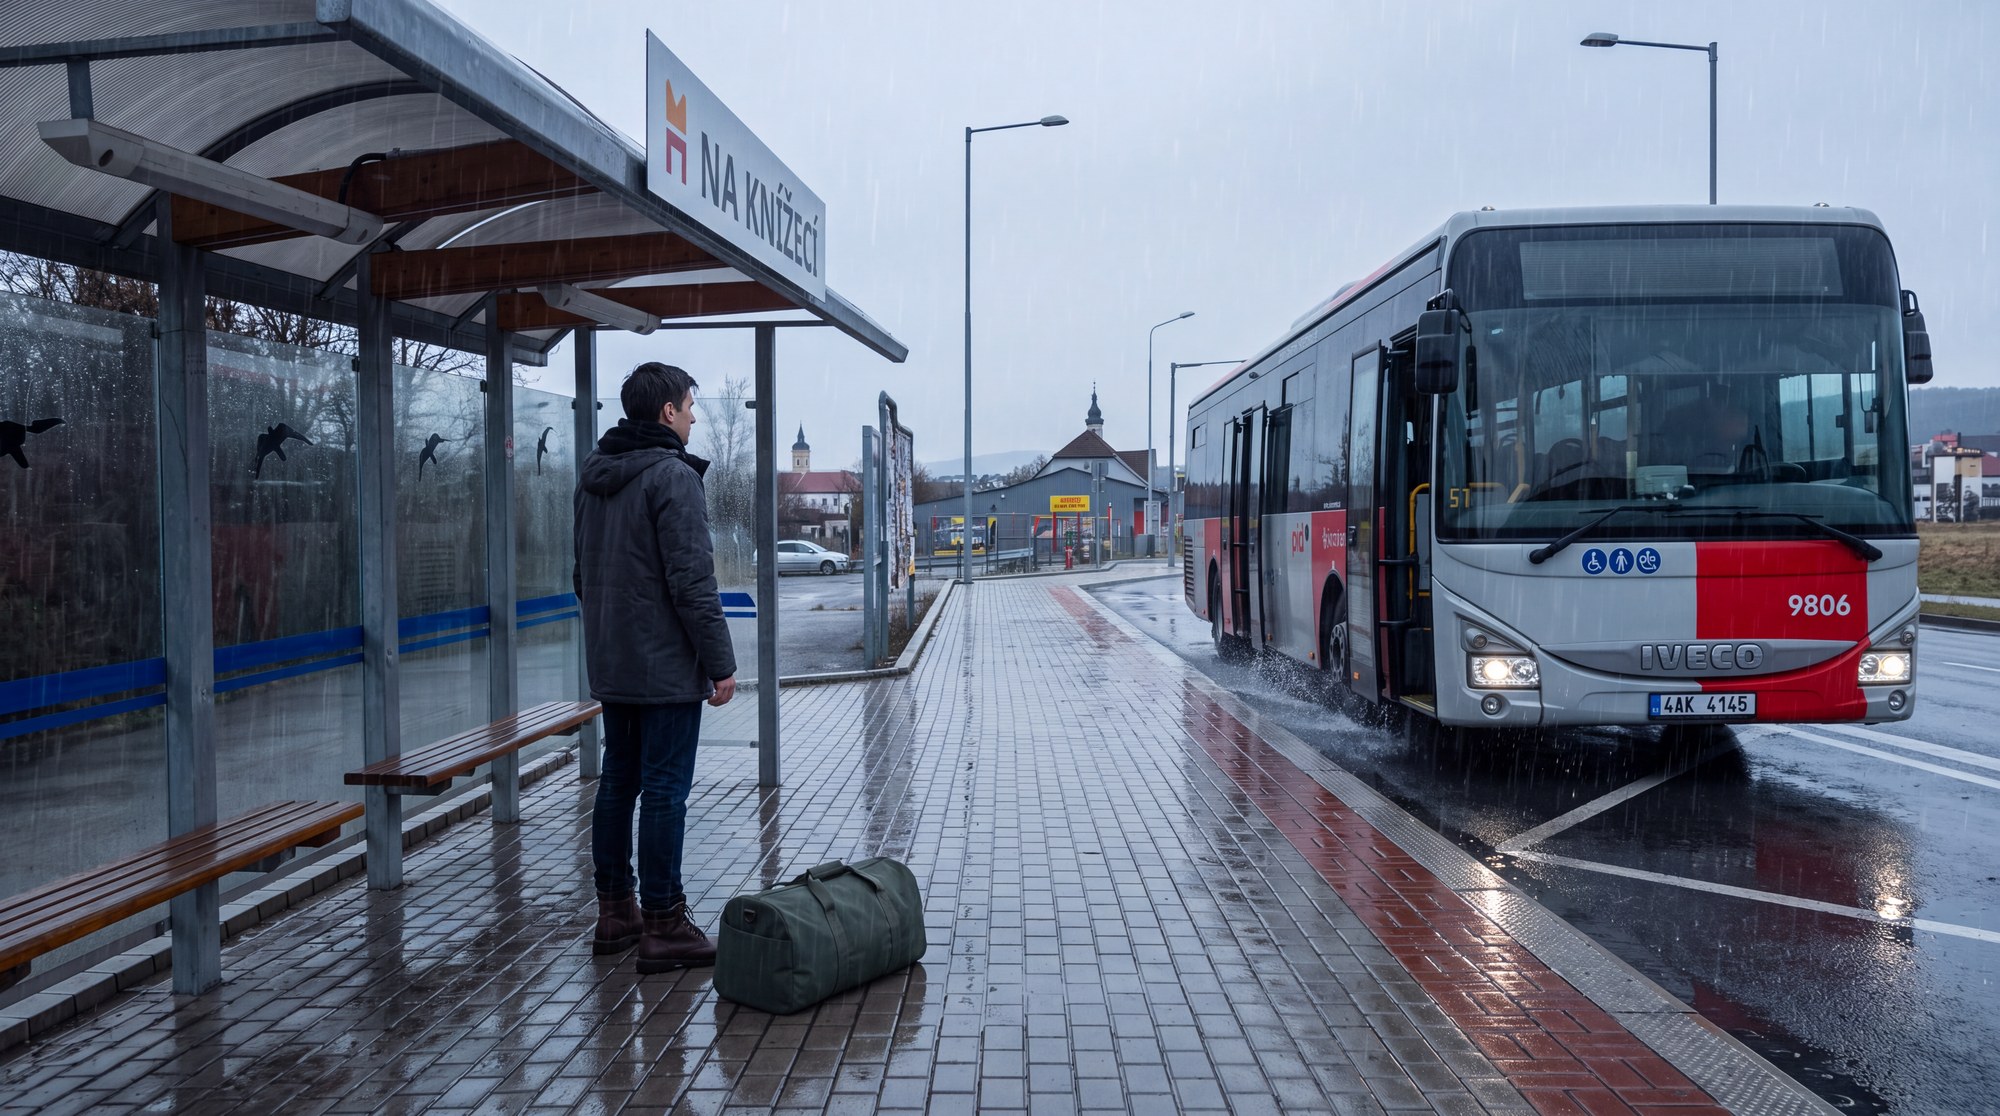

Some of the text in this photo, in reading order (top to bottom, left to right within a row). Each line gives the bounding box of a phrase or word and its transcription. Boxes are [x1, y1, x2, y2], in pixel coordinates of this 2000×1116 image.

[701, 131, 818, 278] NA KNÍŽECÍ
[1291, 523, 1305, 557] pid
[1788, 594, 1851, 616] 9806
[1641, 644, 1764, 670] IVECO
[1664, 695, 1747, 713] 4AK 4145
